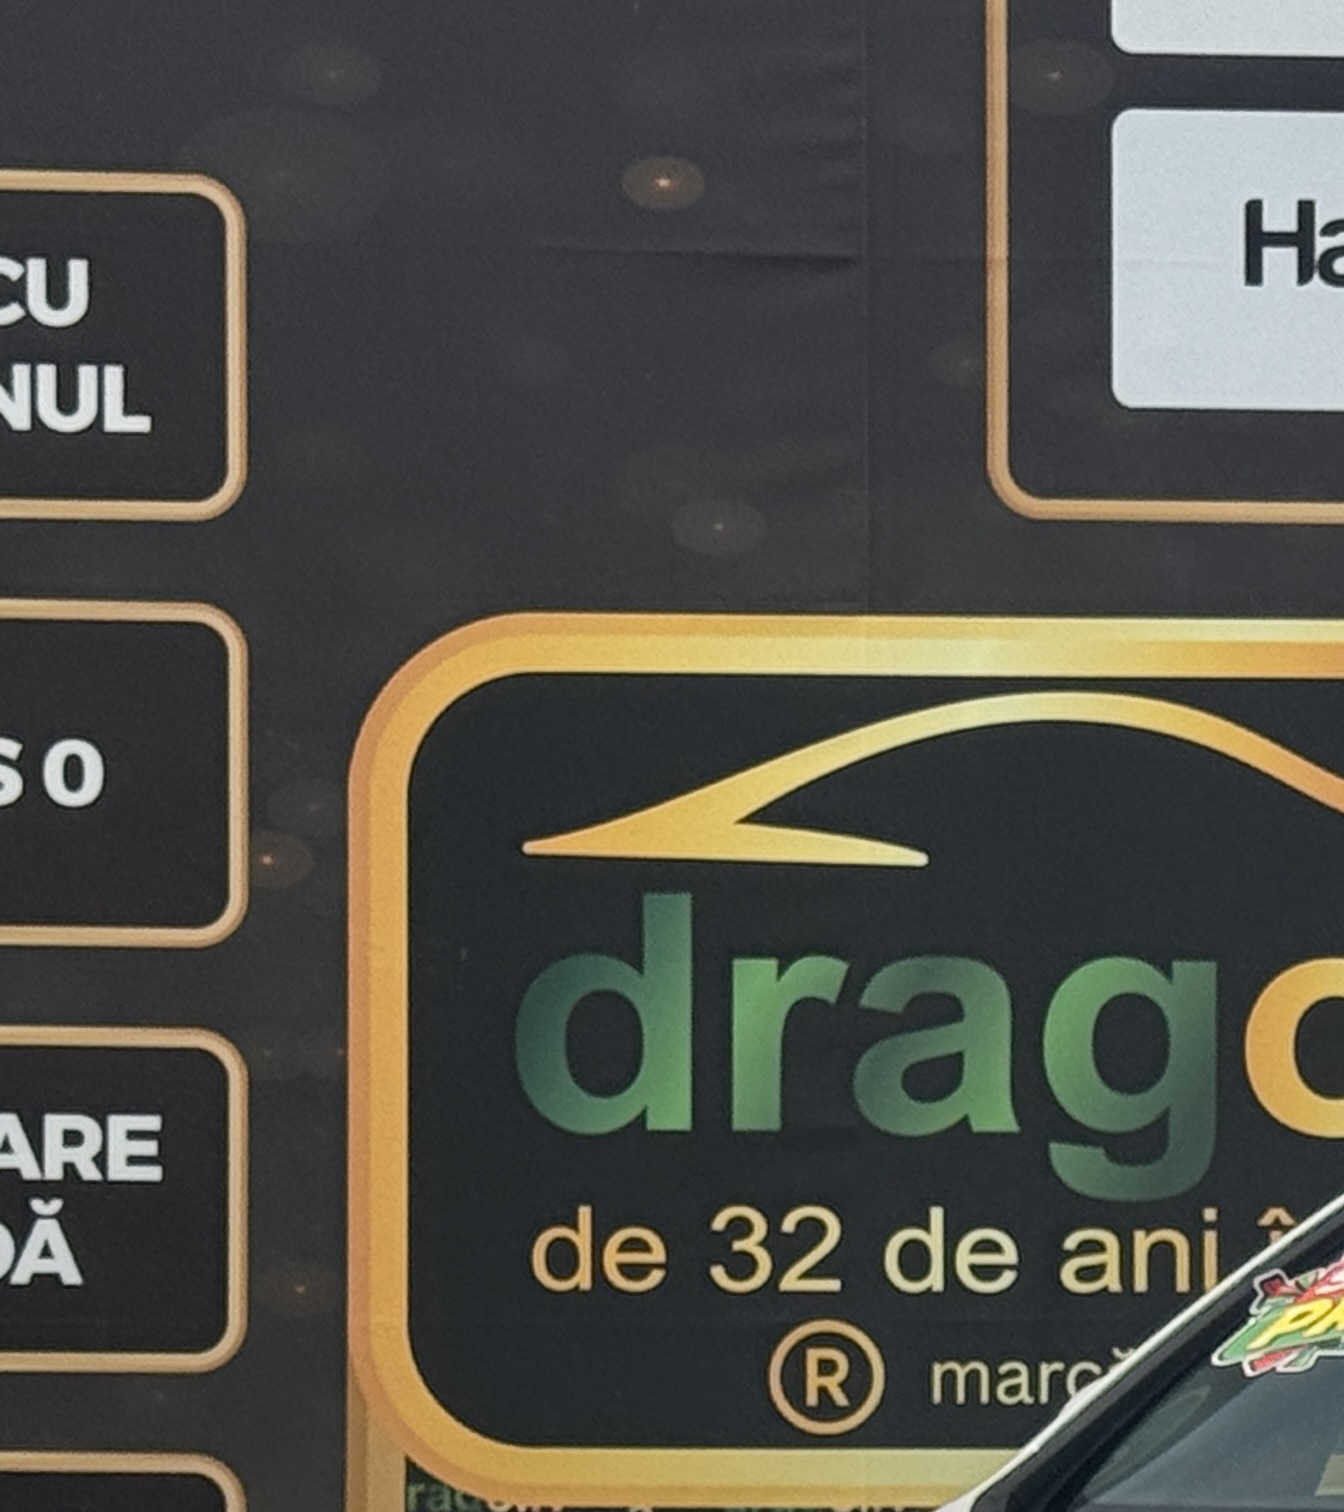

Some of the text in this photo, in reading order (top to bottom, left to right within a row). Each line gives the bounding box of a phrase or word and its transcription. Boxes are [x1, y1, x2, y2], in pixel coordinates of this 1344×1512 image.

[0, 1113, 163, 1181] ARE
[531, 1206, 668, 1292] de
[710, 1206, 842, 1293] 32
[884, 1207, 1019, 1293] de
[1059, 1206, 1218, 1294] ani
[931, 1347, 1133, 1406] marc
